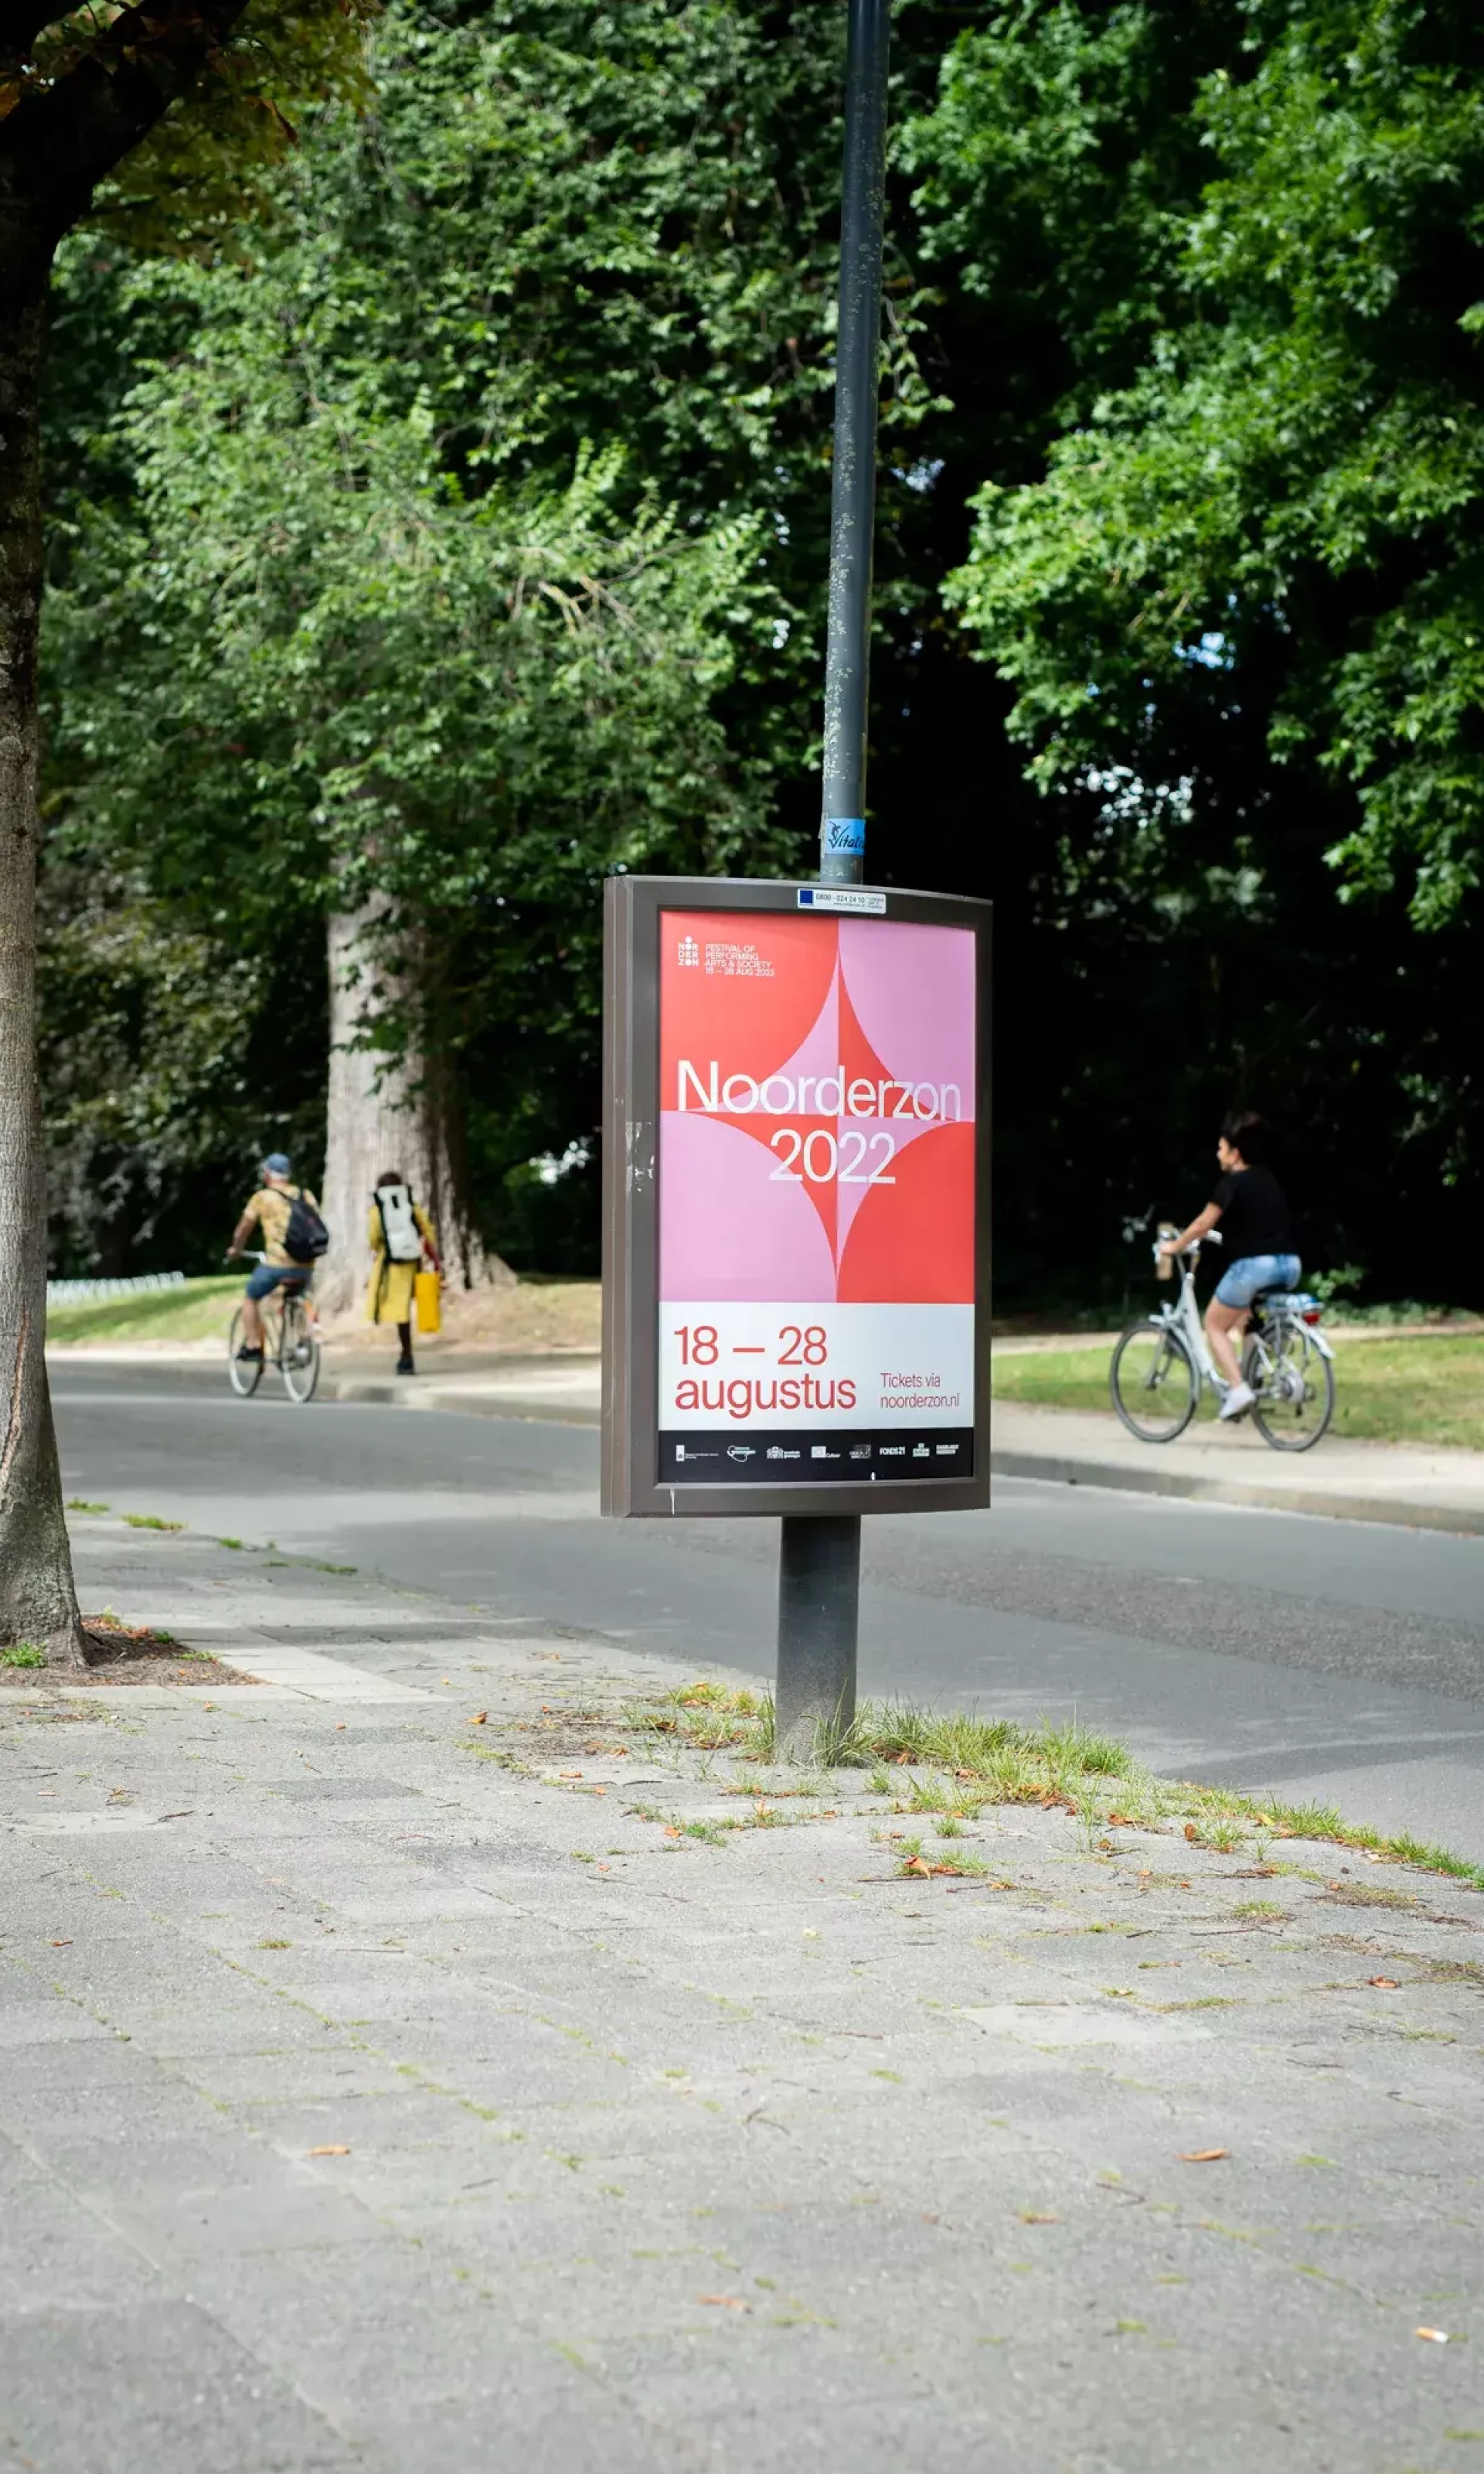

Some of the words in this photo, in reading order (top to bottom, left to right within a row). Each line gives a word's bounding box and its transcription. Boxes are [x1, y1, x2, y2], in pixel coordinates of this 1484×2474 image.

[706, 943, 741, 952] FESTIVAL
[706, 952, 758, 960] PERFORMING
[678, 1060, 961, 1121] Noorderzon
[769, 1129, 896, 1184] 2022
[674, 1326, 719, 1365] 18
[778, 1326, 828, 1365] 28
[880, 1372, 922, 1388] Tickets
[924, 1373, 941, 1388] via
[675, 1373, 857, 1419] augustus
[880, 1394, 959, 1409] noorderzon.nl
